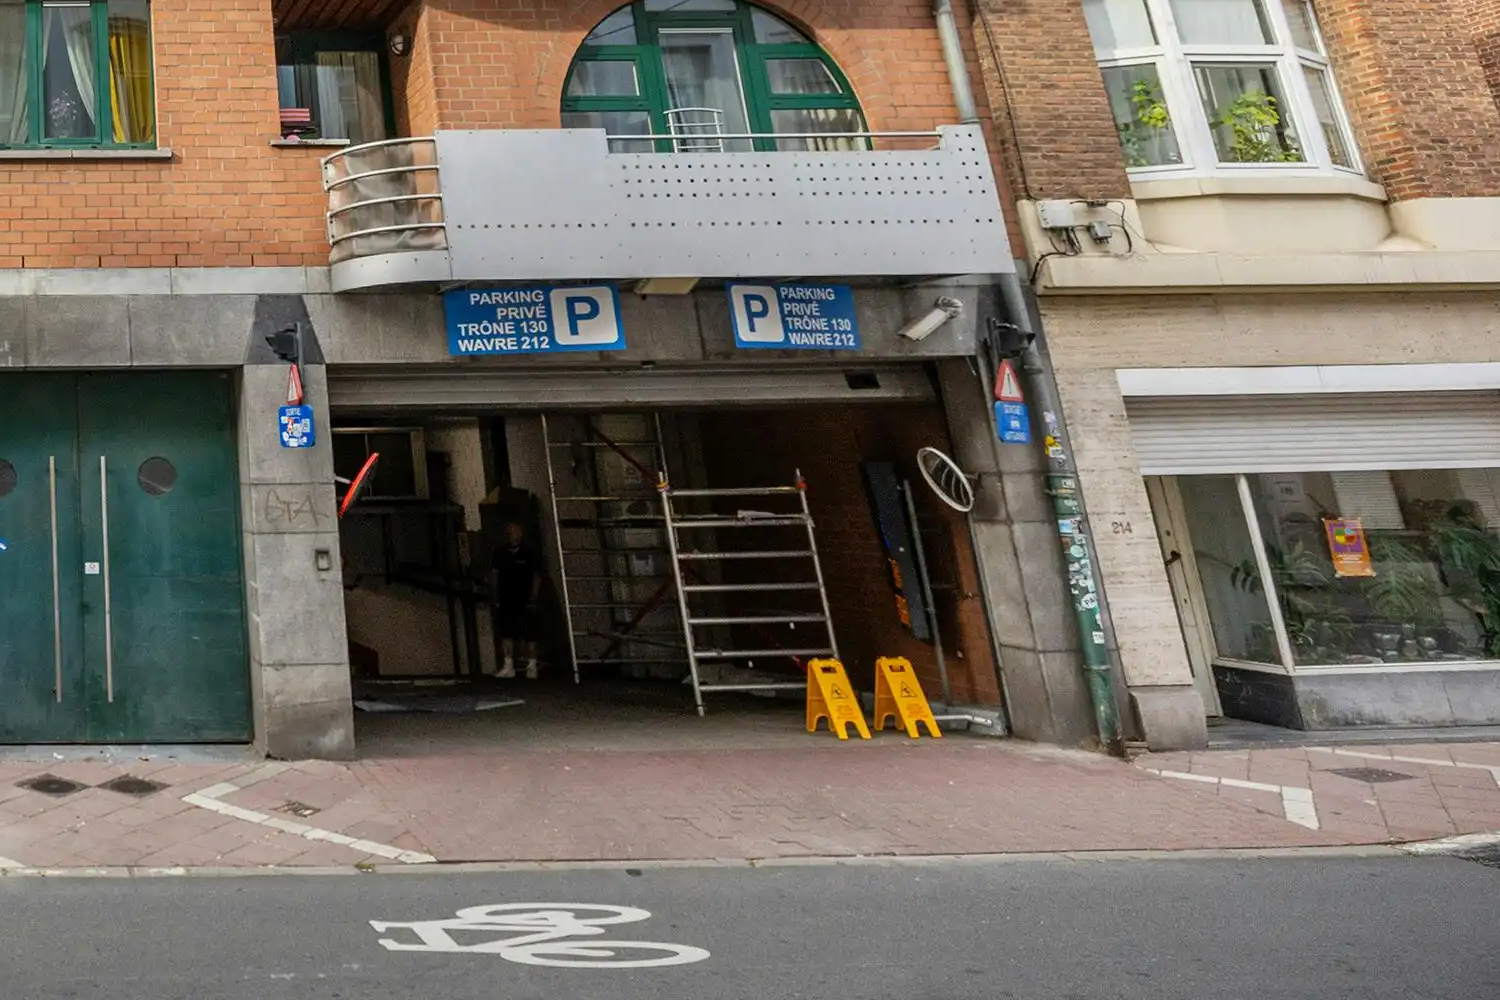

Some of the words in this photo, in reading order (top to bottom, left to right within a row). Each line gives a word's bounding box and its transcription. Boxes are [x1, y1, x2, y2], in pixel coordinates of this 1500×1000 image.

[469, 290, 544, 305] PARKING
[780, 287, 836, 300] PARKING
[496, 303, 547, 319] PRIVÉ
[743, 294, 769, 332] P
[783, 301, 820, 315] PRIVÉ
[565, 296, 600, 336] P
[786, 316, 829, 330] TRÔNE
[831, 318, 851, 331] 130
[457, 321, 516, 336] TRÔNE
[520, 321, 547, 333] 130
[458, 337, 518, 352] WAVRE
[521, 336, 550, 349] 212
[788, 332, 832, 346] WAVRE
[833, 333, 855, 346] 212
[1111, 521, 1133, 534] 214
